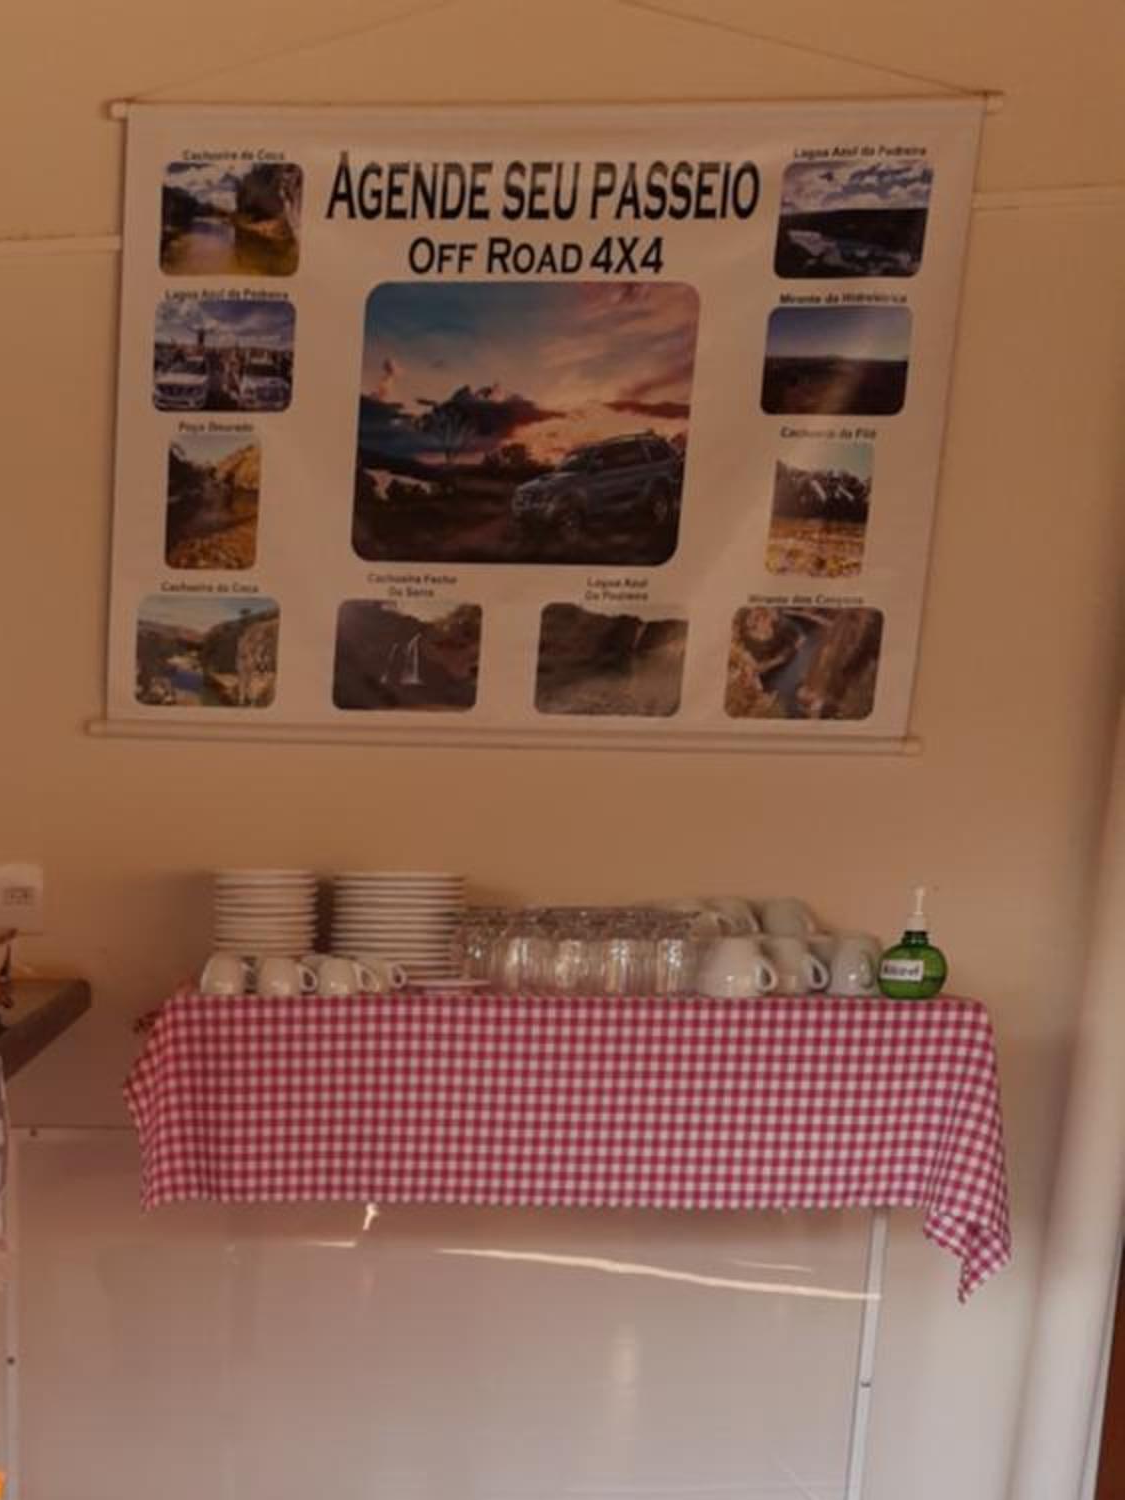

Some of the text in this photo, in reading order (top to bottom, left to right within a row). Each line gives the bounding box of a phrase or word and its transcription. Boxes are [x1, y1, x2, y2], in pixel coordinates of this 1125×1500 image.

[325, 150, 761, 220] AGENDE SEU PASSEIO
[408, 236, 664, 274] OFF ROAD 4X4
